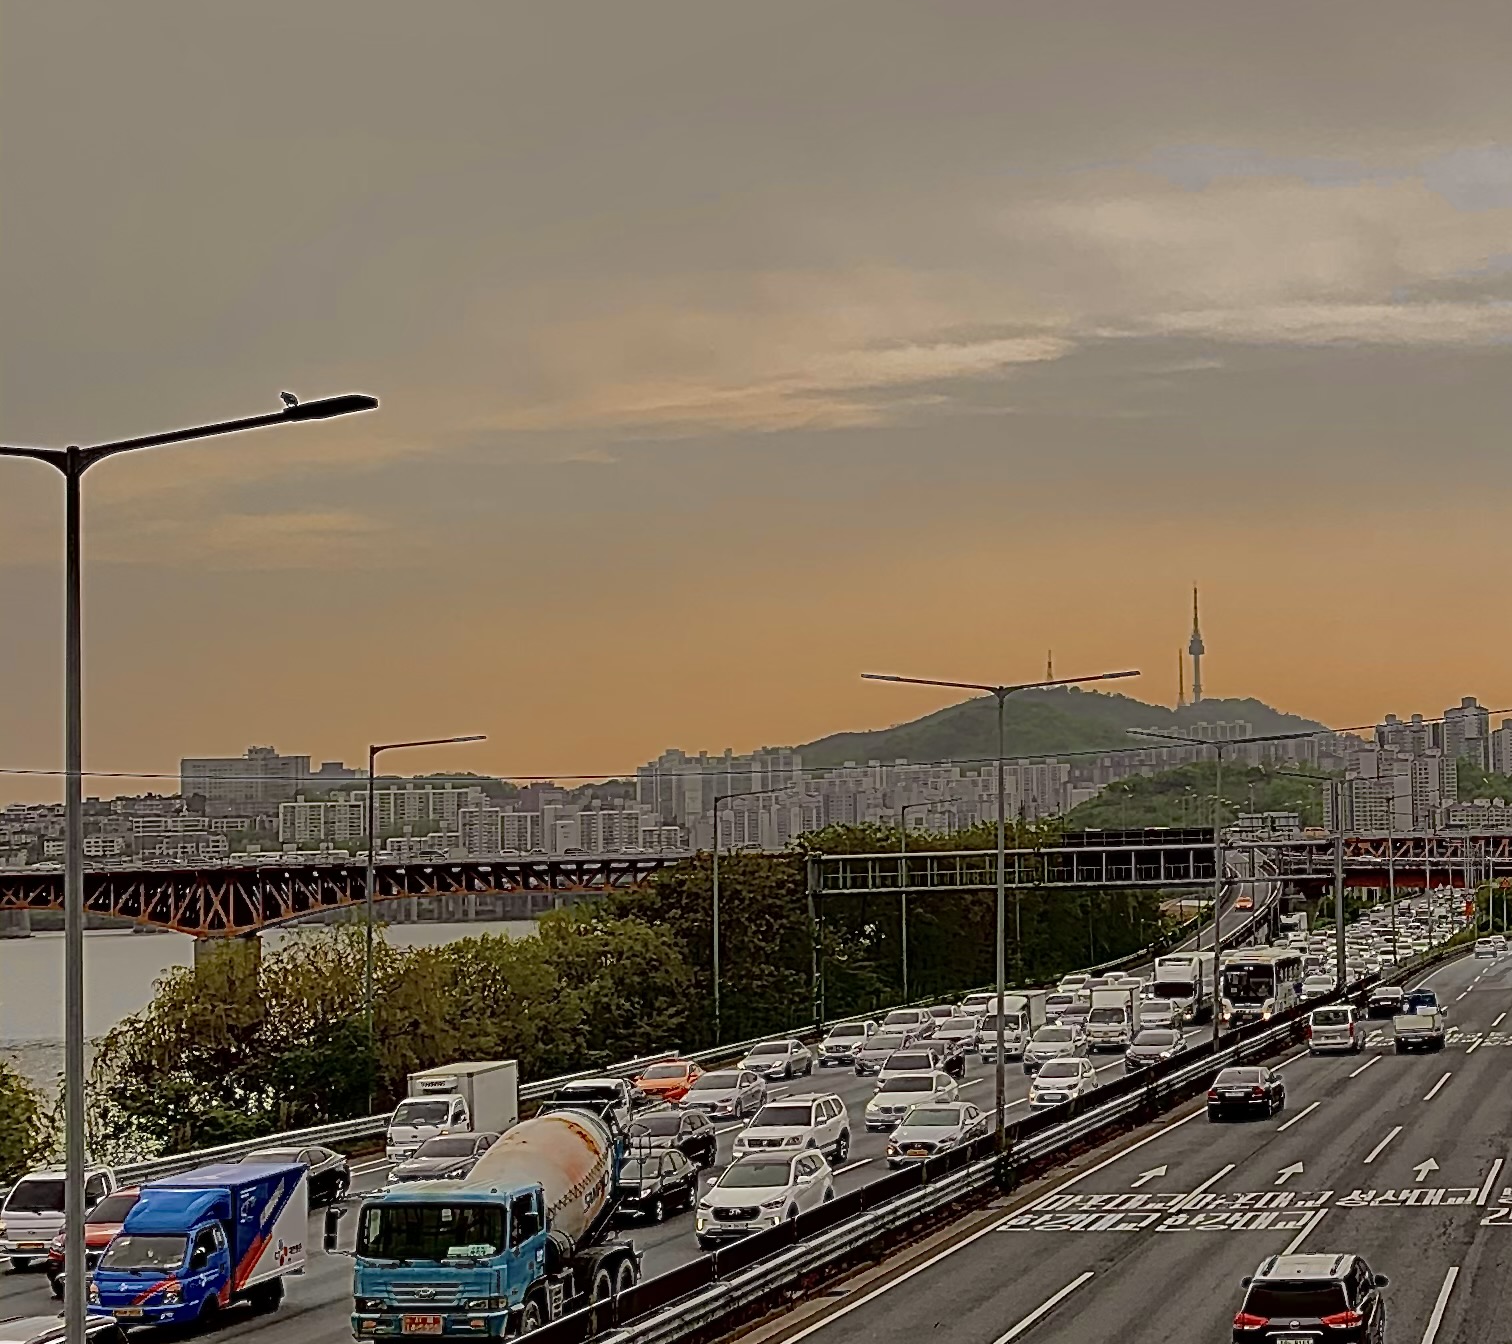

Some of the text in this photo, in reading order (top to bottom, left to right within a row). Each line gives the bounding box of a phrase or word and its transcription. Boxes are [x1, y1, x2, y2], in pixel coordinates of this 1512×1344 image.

[1031, 1193, 1188, 1212] 마포대교
[1181, 1190, 1334, 1210] 마포대교
[1335, 1188, 1479, 1207] 성산대교
[995, 1212, 1162, 1232] 한강대교
[1154, 1211, 1316, 1232] 한강대교
